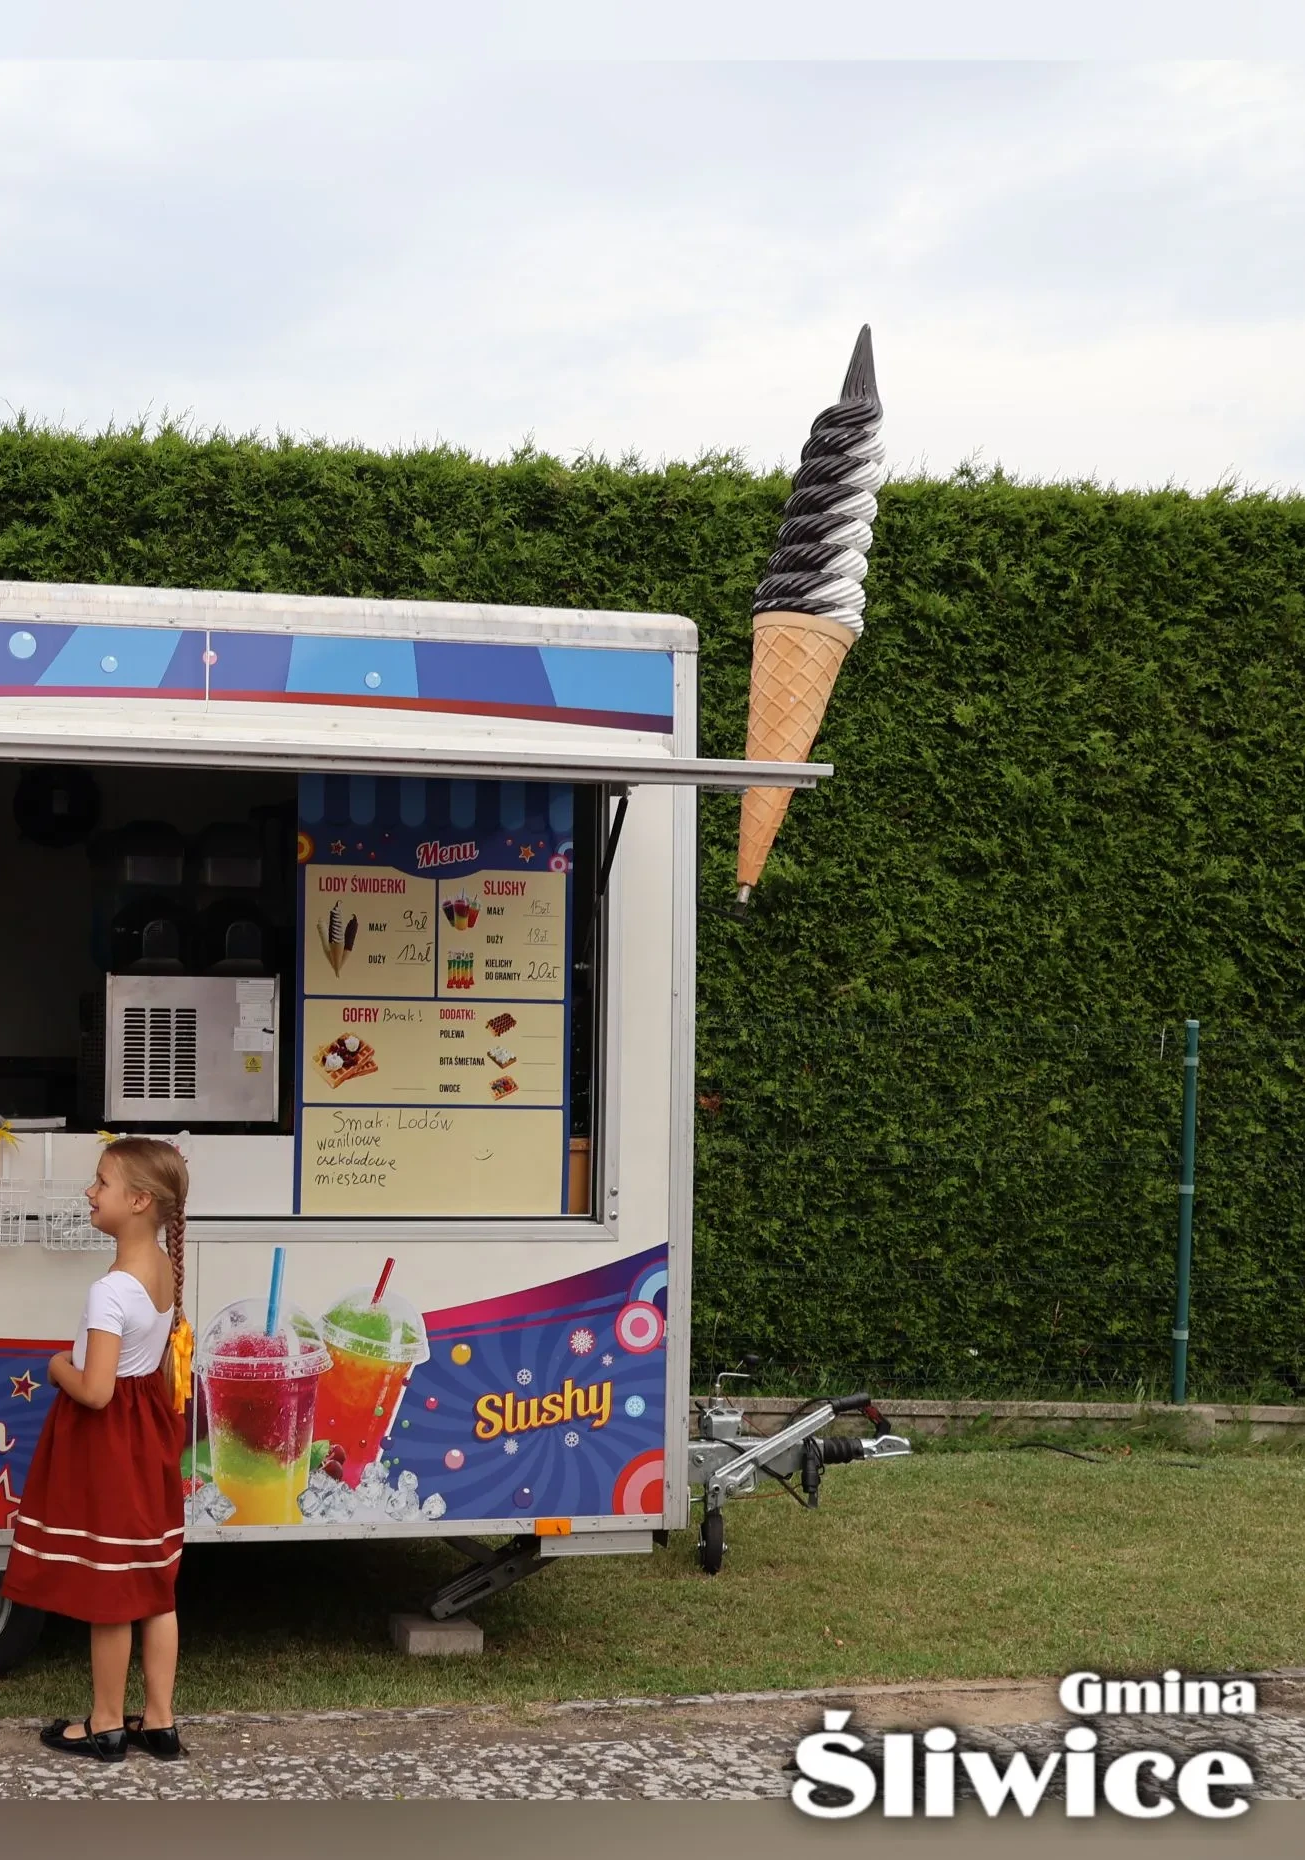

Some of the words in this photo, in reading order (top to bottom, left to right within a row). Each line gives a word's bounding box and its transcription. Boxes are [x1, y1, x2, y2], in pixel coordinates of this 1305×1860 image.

[416, 840, 479, 868] Menu
[319, 877, 347, 892] LODY
[351, 875, 406, 894] ŚWIDERKI
[483, 880, 527, 896] SLUSHY
[486, 907, 505, 916] MAŁY
[368, 923, 387, 932] MAŁY
[486, 935, 504, 944] DUŻY
[368, 955, 386, 964] DUŻY
[485, 959, 513, 968] KIELICHY
[485, 972, 494, 980] DO
[495, 972, 521, 981] GRANITY
[342, 1007, 380, 1023] GOFRY
[439, 1008, 476, 1021] DODATKI:
[439, 1029, 465, 1039] POLEWA
[439, 1056, 453, 1066] BITA
[454, 1056, 485, 1067] ŚMIETANA
[439, 1084, 461, 1093] OWOCE
[398, 1109, 454, 1131] Lodów
[474, 1378, 613, 1441] Slushy
